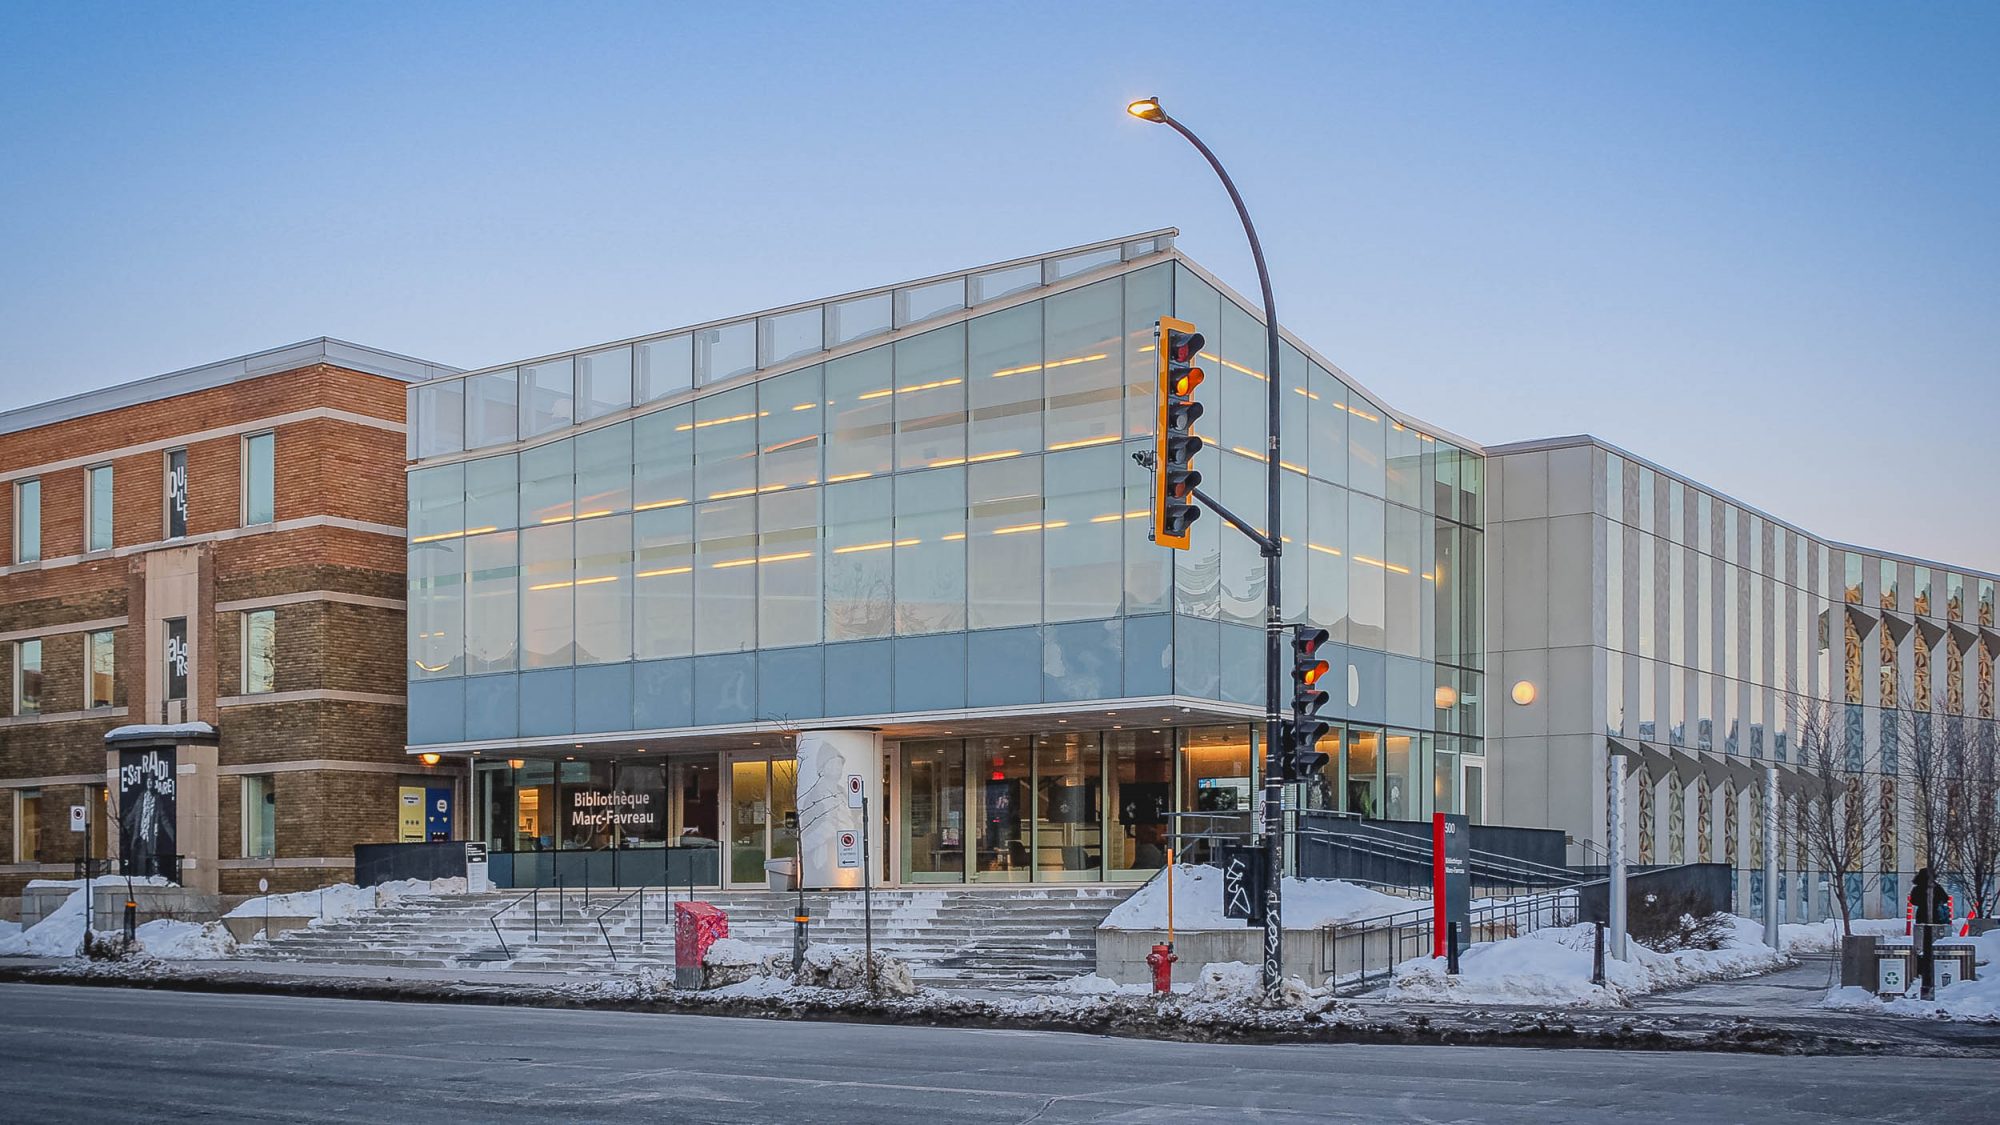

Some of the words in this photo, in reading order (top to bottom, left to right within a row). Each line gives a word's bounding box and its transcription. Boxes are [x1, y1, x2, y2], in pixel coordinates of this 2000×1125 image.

[574, 790, 650, 809] Bibliothèque
[572, 810, 654, 826] Marc-Favreau
[1445, 822, 1456, 834] 500
